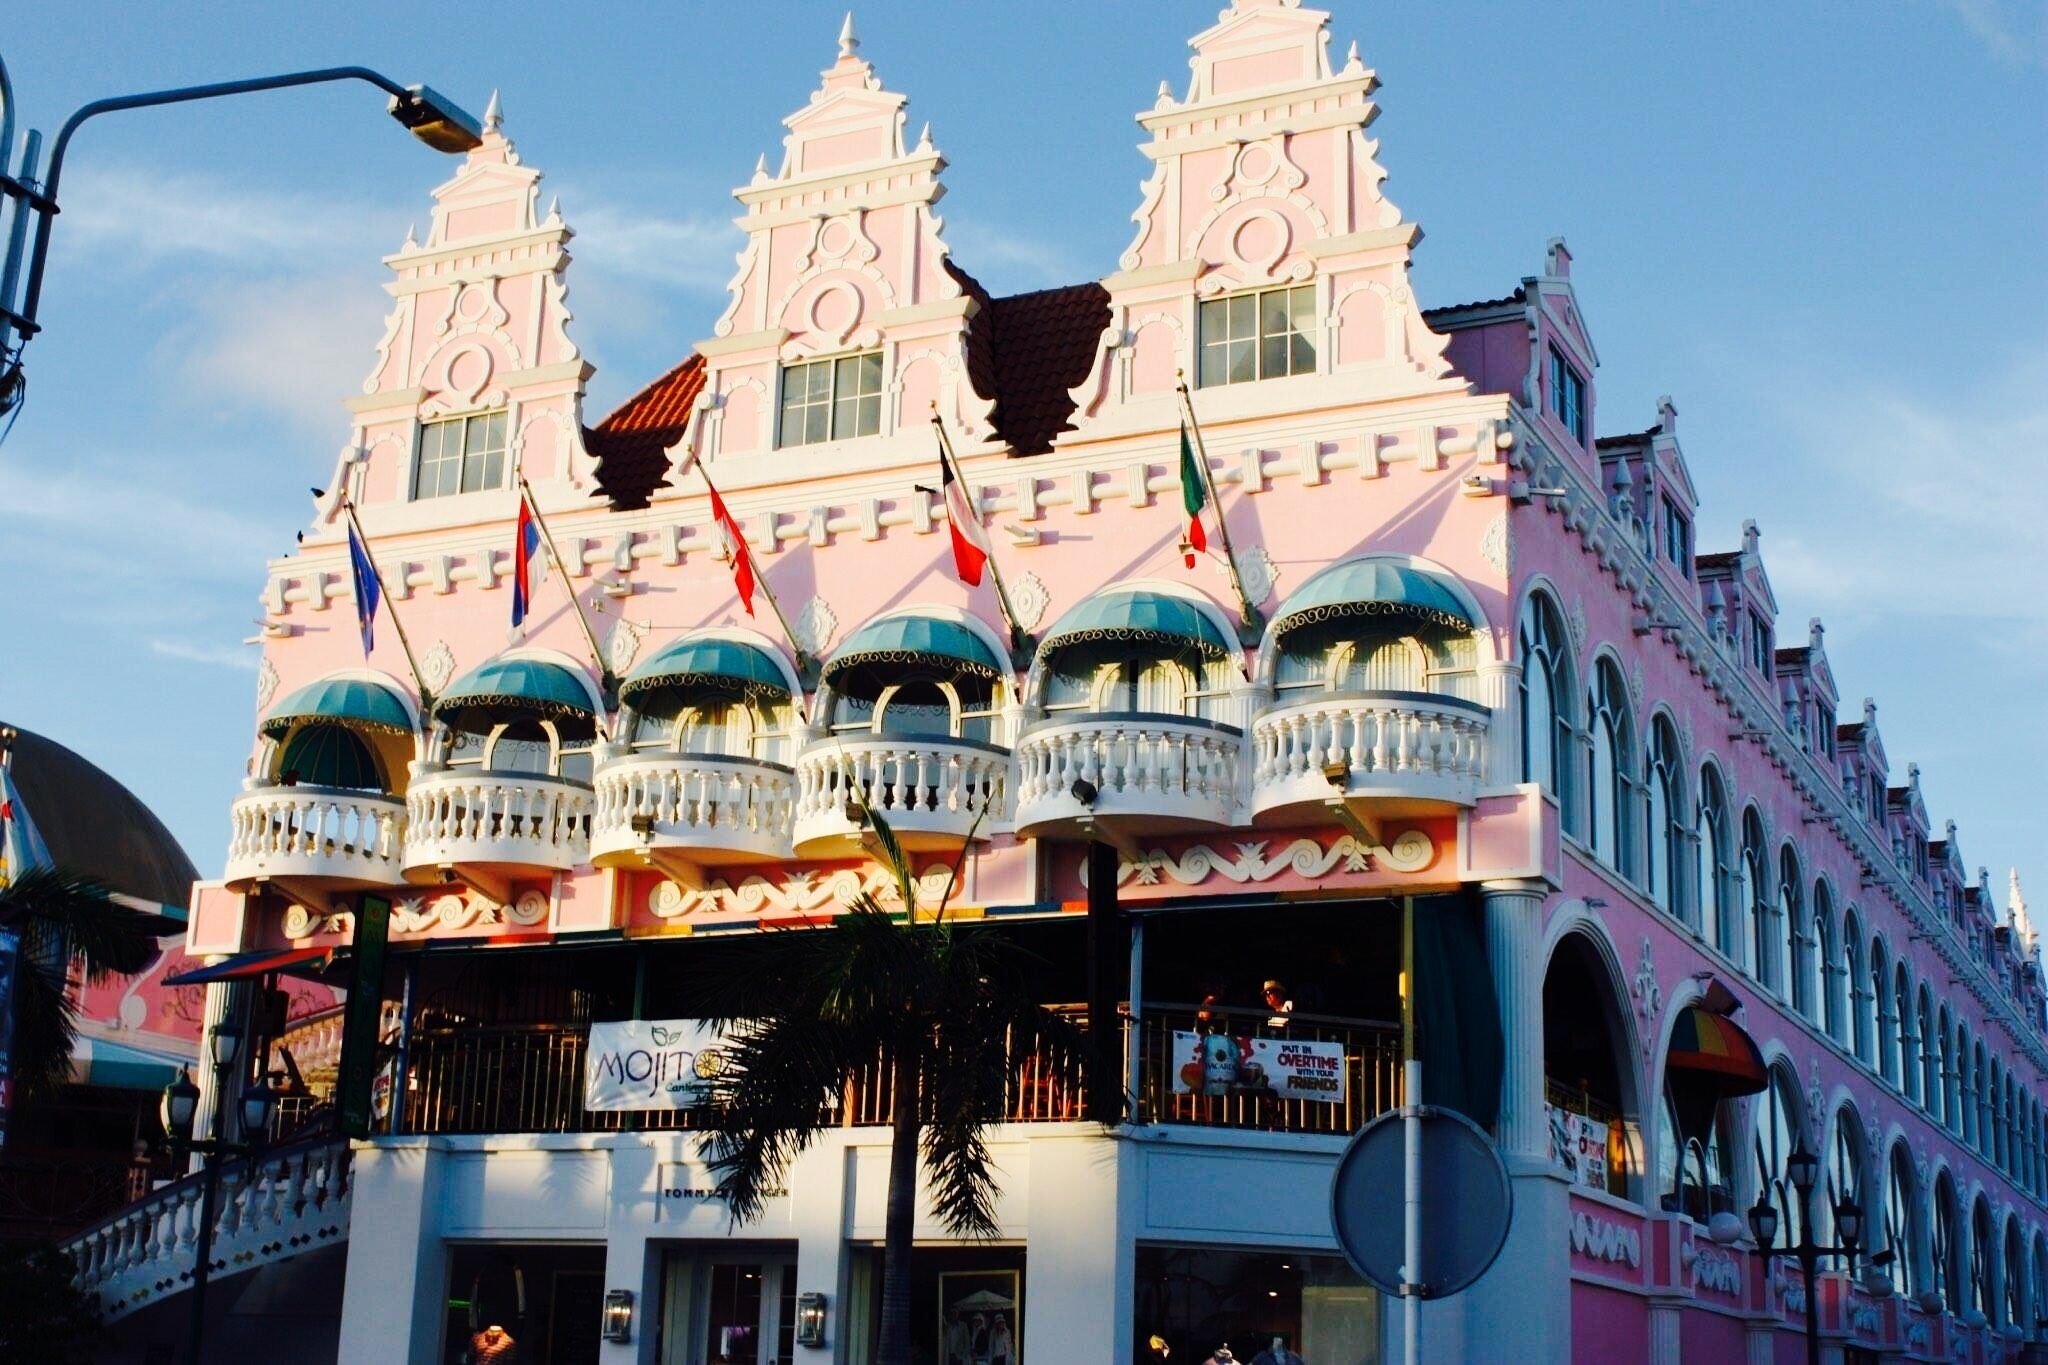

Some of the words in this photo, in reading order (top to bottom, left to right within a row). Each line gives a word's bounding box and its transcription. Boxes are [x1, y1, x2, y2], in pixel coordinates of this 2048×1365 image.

[1281, 1045, 1299, 1054] PUT
[1302, 1046, 1312, 1054] IN
[1277, 1053, 1339, 1070] OVERTIME
[595, 1049, 730, 1098] MOJITO
[1296, 1068, 1314, 1076] WITH
[1316, 1069, 1335, 1077] YOUR
[1287, 1075, 1339, 1091] FRIENDS
